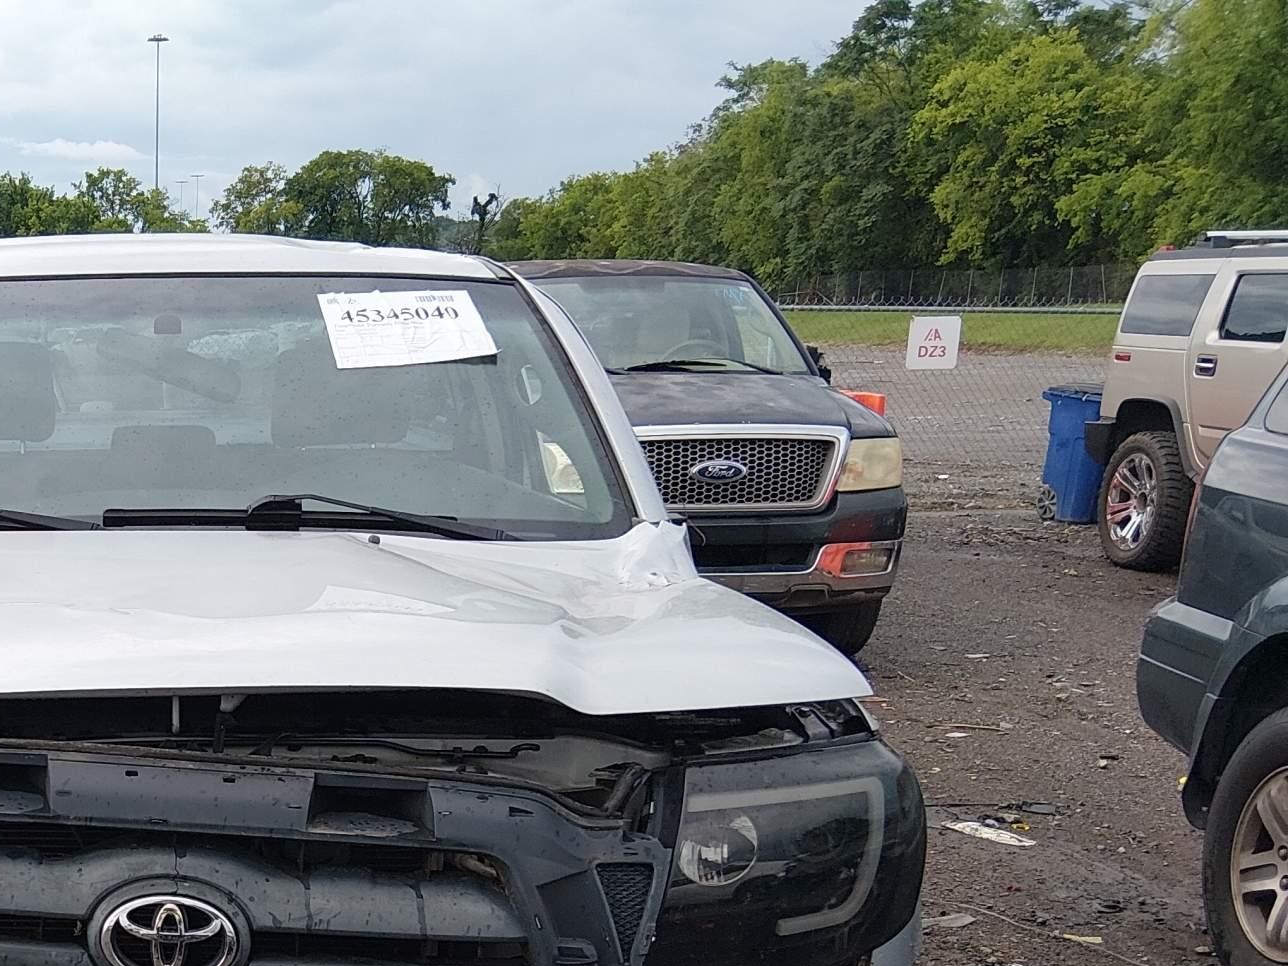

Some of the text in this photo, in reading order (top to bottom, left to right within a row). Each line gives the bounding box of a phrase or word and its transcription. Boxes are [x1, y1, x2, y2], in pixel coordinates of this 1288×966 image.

[340, 306, 460, 324] 45345040
[917, 345, 947, 358] DZ3
[704, 465, 737, 477] Ford
